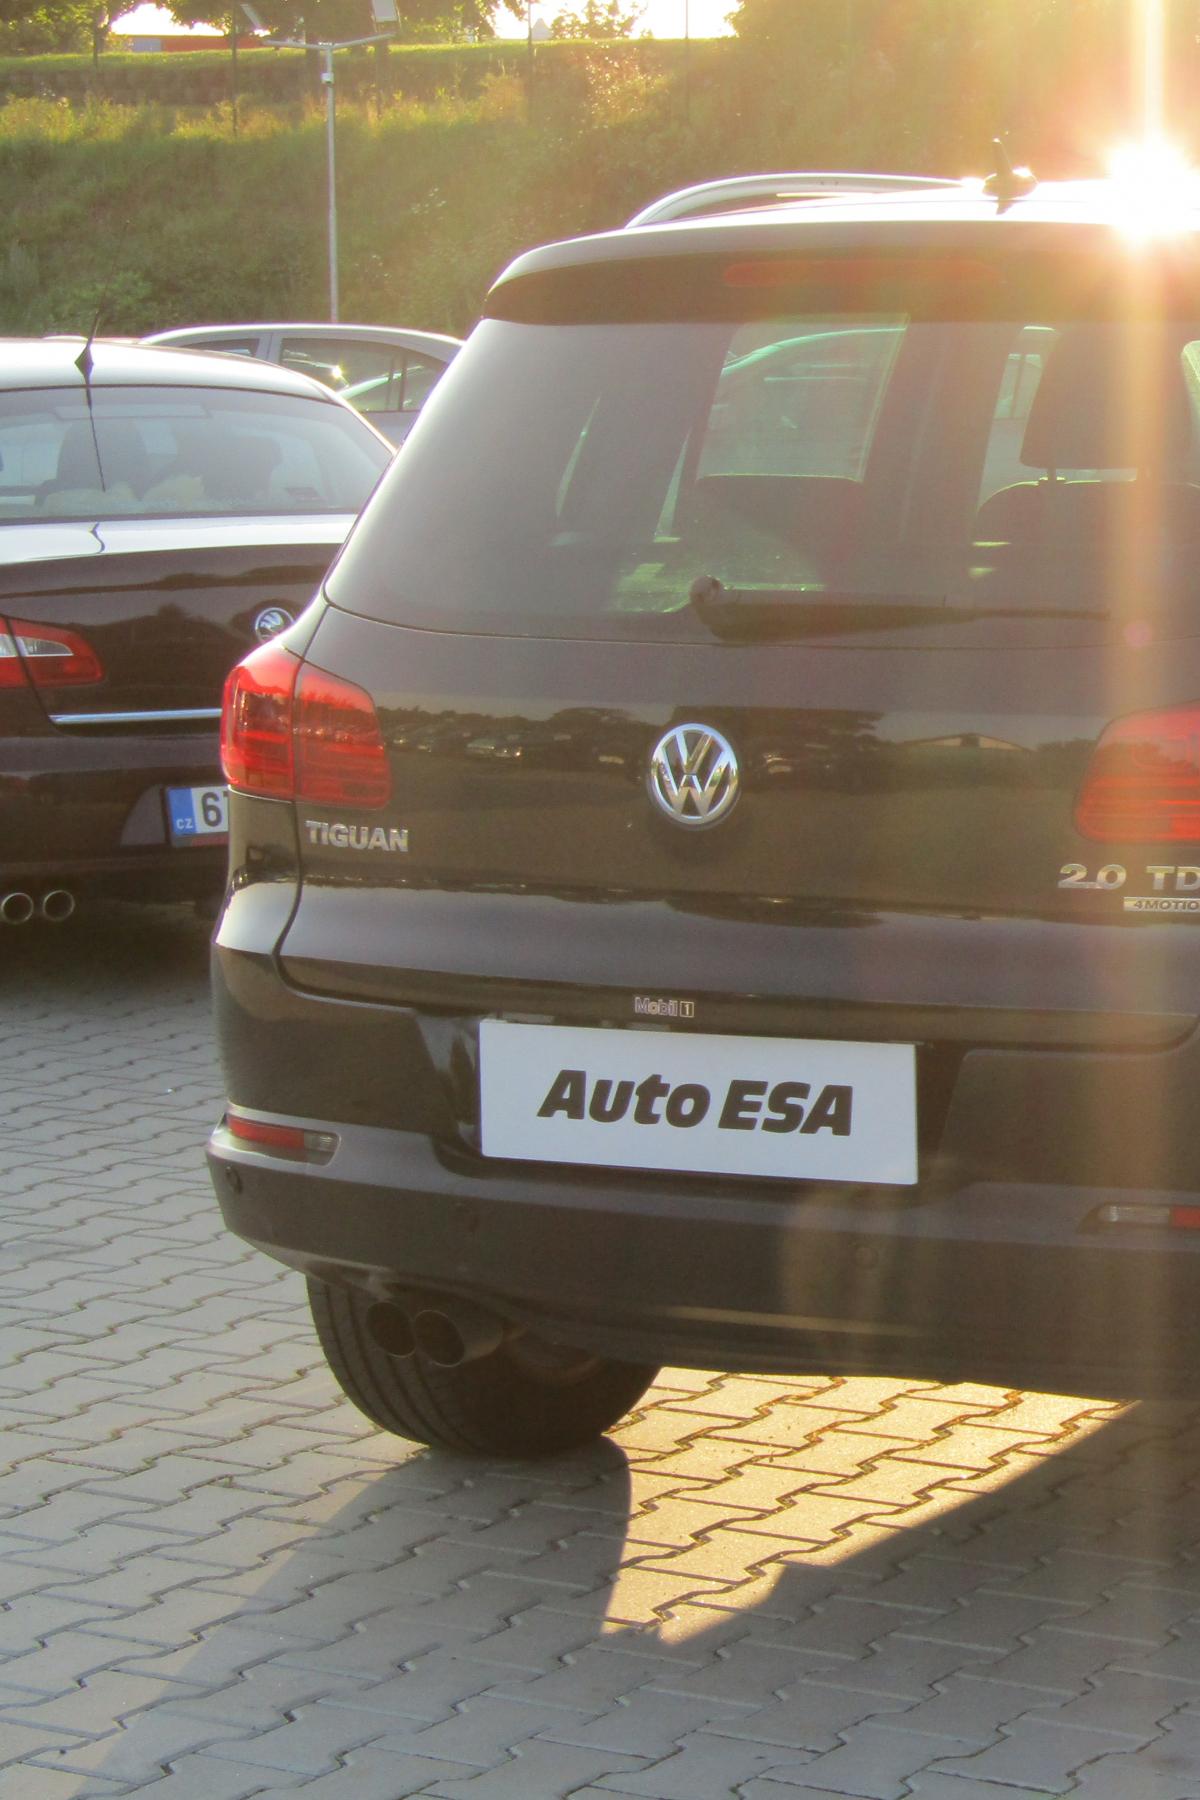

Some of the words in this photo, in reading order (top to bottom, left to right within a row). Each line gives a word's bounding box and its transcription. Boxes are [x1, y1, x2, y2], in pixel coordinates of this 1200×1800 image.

[201, 791, 228, 827] 6
[176, 818, 193, 830] CZ
[305, 820, 409, 852] TIGUAN
[1058, 863, 1127, 890] 2.0
[634, 996, 679, 1017] Mobil
[680, 1001, 695, 1018] 1
[536, 1069, 711, 1128] Auto
[717, 1079, 854, 1137] ESA
